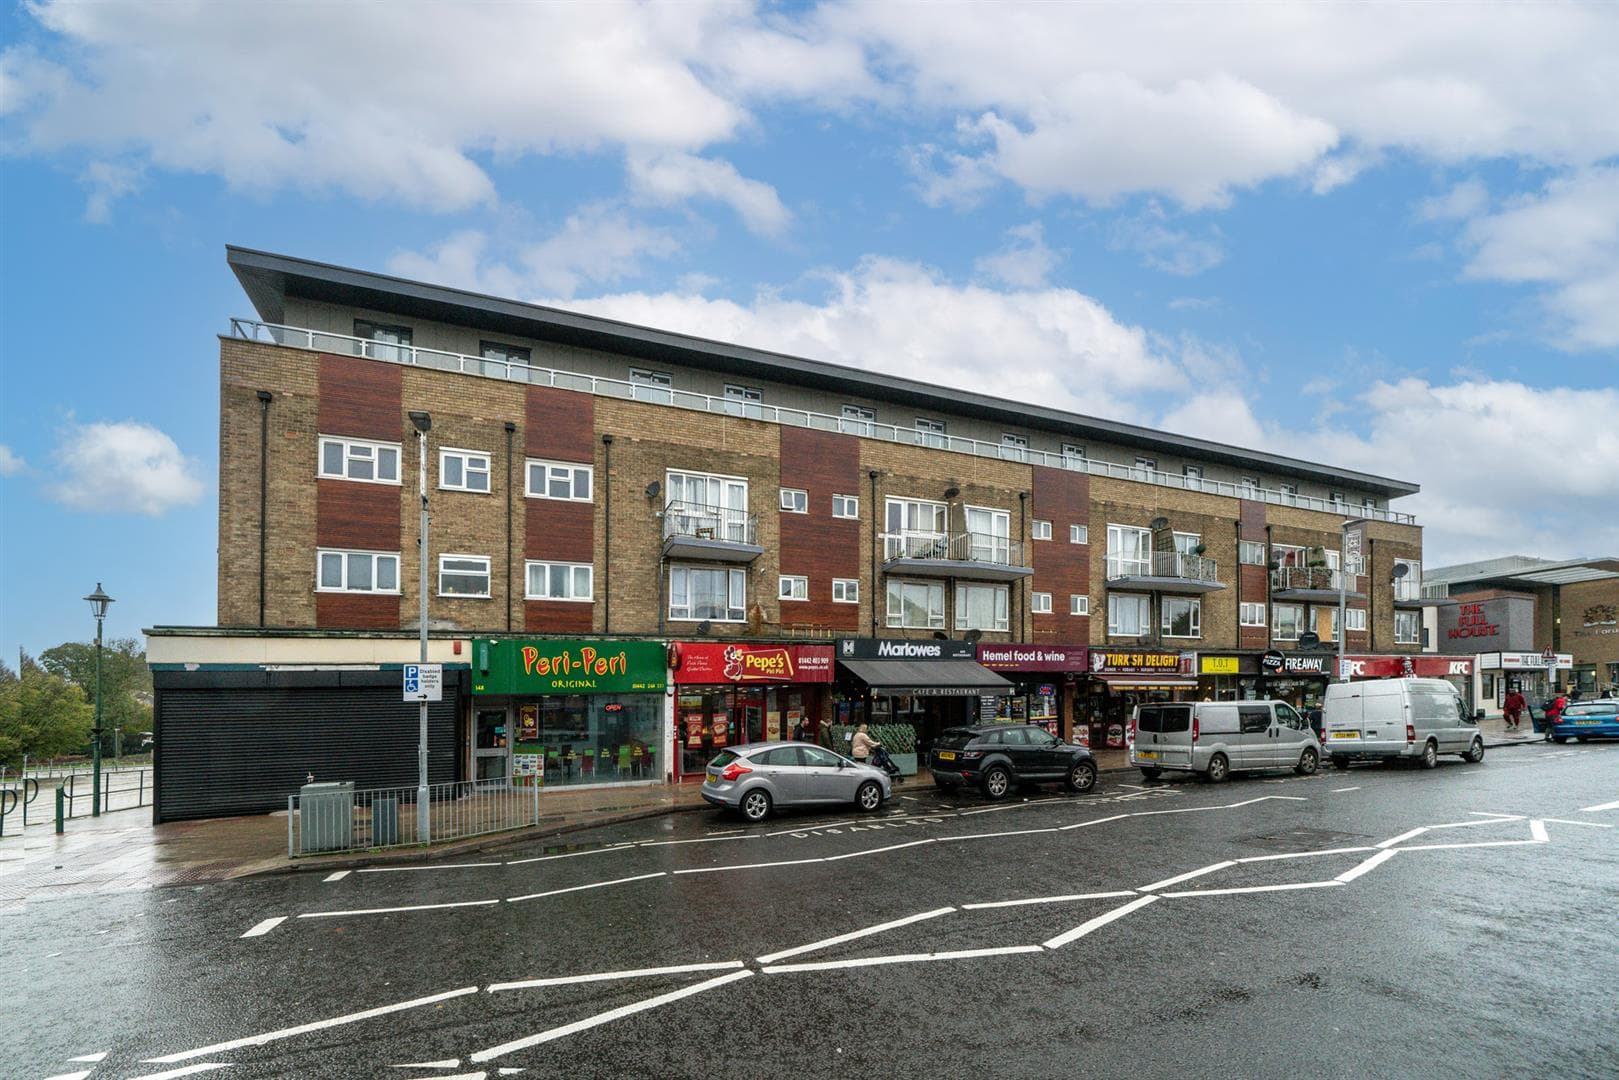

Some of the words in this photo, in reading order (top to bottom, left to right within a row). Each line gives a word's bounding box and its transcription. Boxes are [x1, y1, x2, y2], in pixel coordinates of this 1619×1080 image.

[1459, 603, 1484, 615] THE
[1458, 614, 1488, 626] FULL
[1448, 624, 1500, 639] HOUSE
[878, 641, 941, 657] Marlowes
[521, 647, 626, 675] Peri-Peri
[746, 654, 785, 671] Pepe's
[982, 650, 1012, 662] Hemel
[1014, 650, 1036, 662] food
[1036, 651, 1044, 662] &
[1044, 651, 1066, 662] wine
[1145, 655, 1180, 667] DELIGHT
[1263, 658, 1281, 667] PIZZA
[1285, 657, 1323, 673] FIREAWAY
[1350, 661, 1366, 676] FC
[1448, 661, 1470, 675] KFC
[408, 667, 417, 678] P
[940, 688, 980, 696] RESTAURANT
